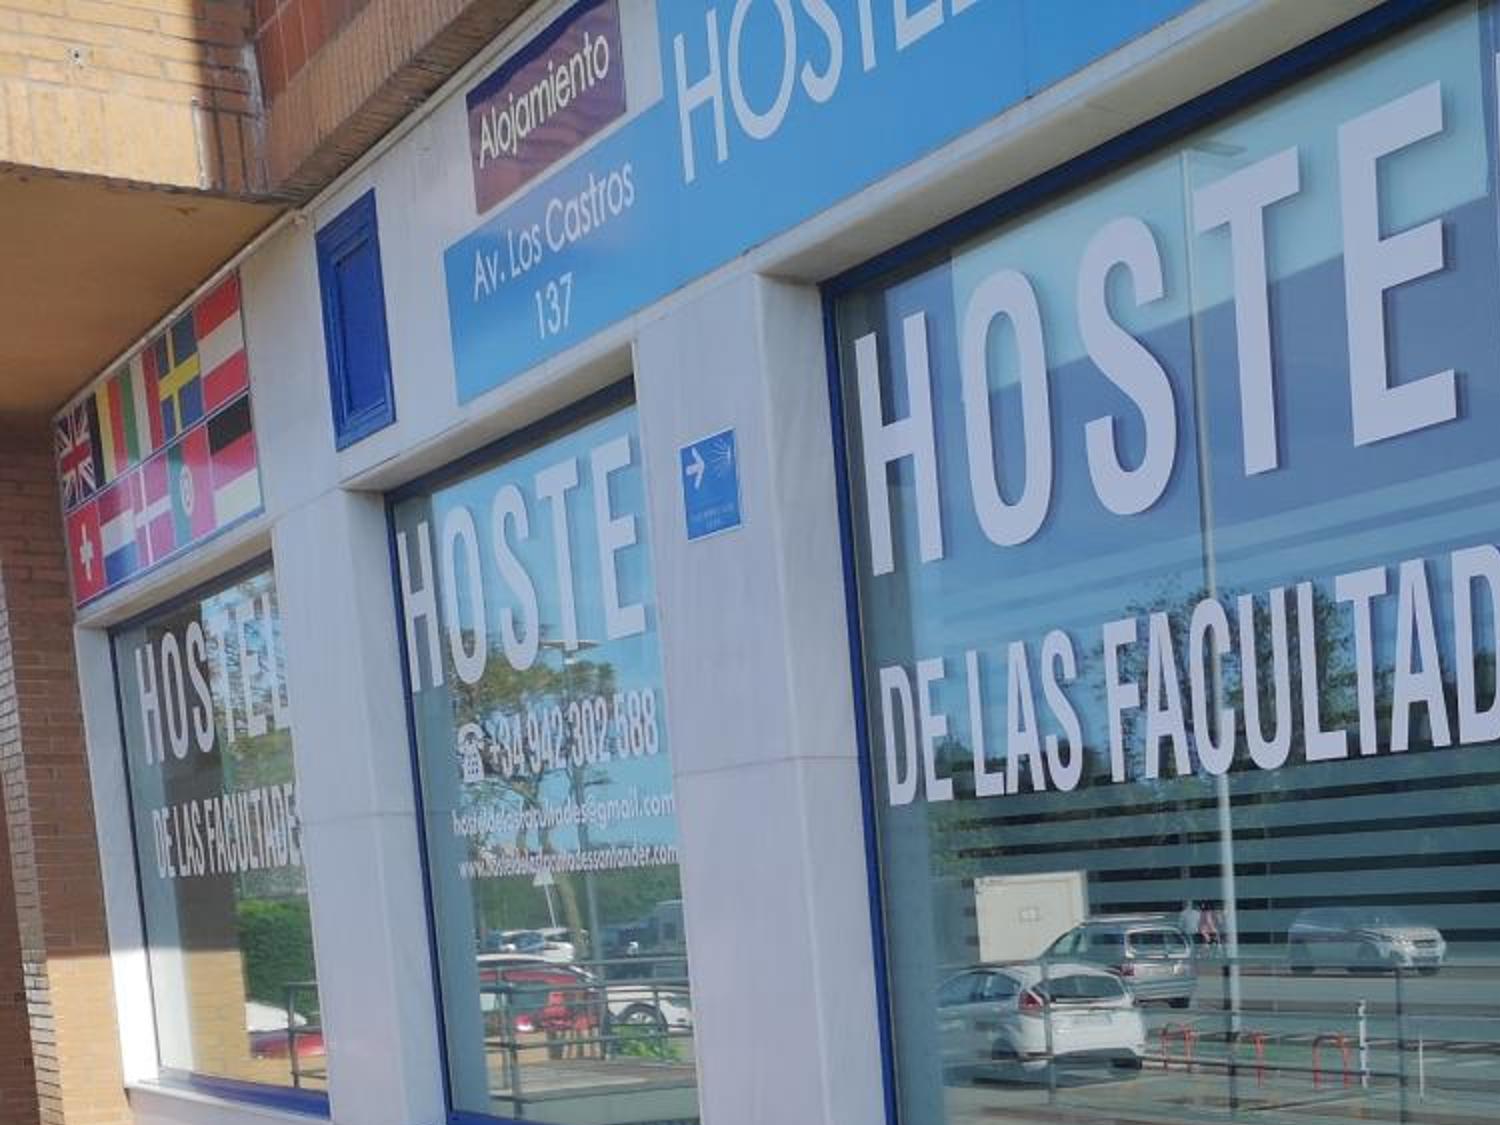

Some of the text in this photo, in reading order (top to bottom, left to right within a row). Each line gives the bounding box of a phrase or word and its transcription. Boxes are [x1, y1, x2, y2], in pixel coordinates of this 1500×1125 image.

[479, 31, 610, 169] Alojamiento
[473, 160, 635, 301] Av. Los Castros
[535, 271, 574, 340] 137
[527, 704, 567, 774] 942
[568, 695, 611, 768] 302
[613, 687, 659, 758] 588
[879, 656, 954, 806] DE
[965, 629, 1084, 798] LAS
[152, 806, 176, 880] DE
[173, 798, 206, 878] LAS
